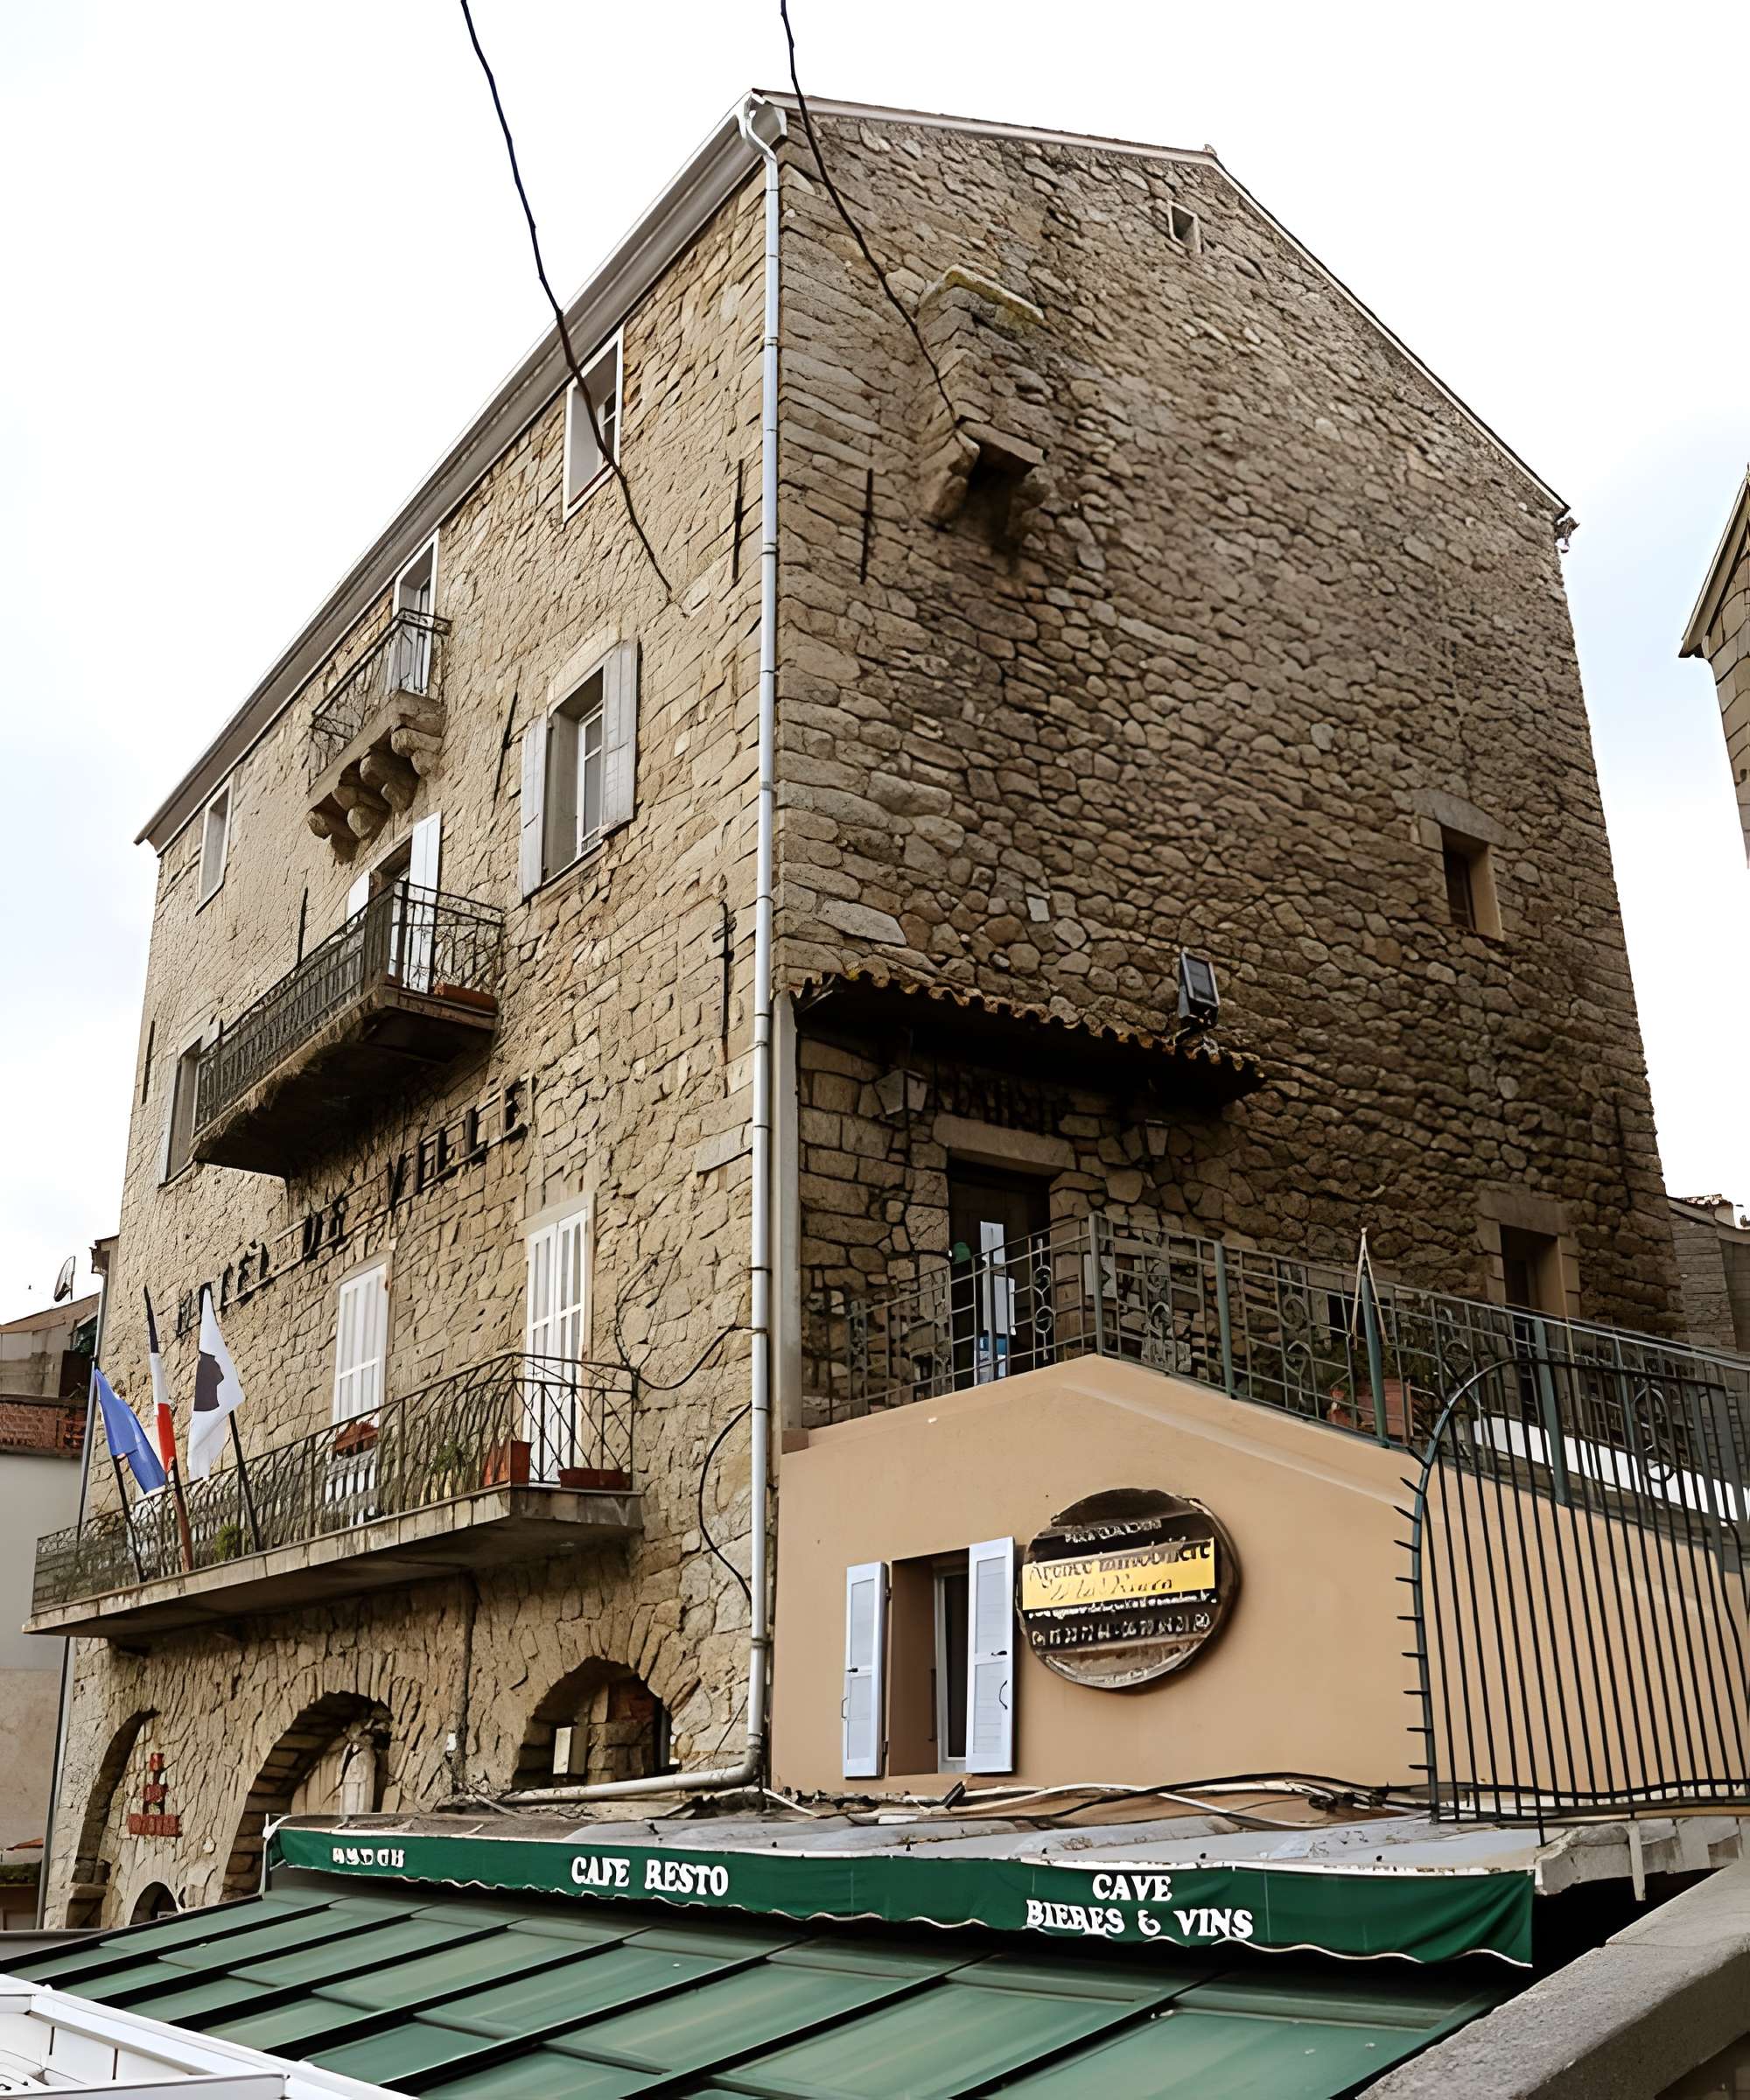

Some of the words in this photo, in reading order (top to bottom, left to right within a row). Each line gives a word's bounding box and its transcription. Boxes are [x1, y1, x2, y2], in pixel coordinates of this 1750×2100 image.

[571, 1856, 630, 1886] CAFE
[644, 1858, 730, 1897] RESTO
[1092, 1874, 1172, 1901] CAVE
[1026, 1900, 1126, 1933] BIERES
[1138, 1909, 1161, 1936] &
[1173, 1909, 1254, 1939] VINS
